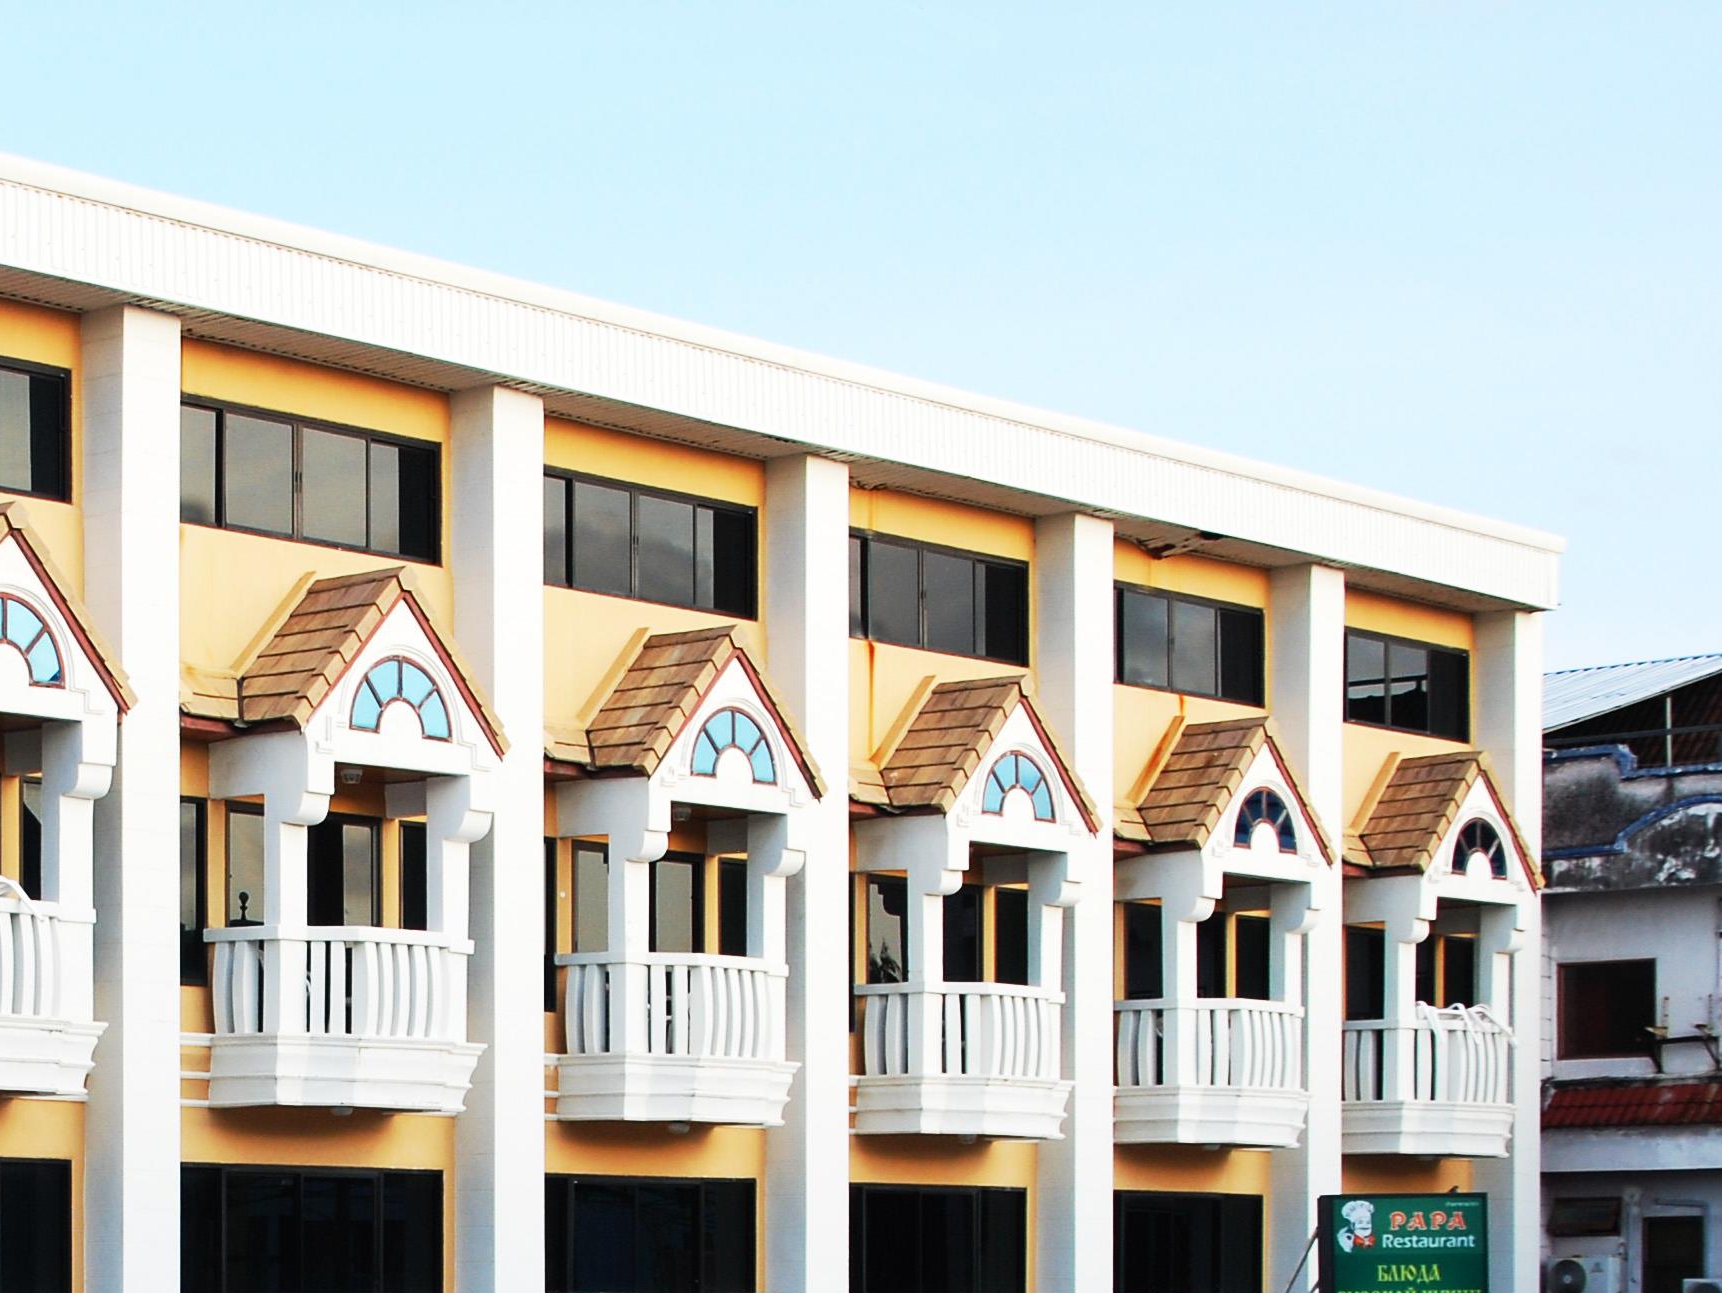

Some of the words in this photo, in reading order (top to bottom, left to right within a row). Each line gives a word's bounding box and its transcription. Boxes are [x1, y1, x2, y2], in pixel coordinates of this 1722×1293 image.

[1389, 1210, 1467, 1232] PAPA
[1381, 1233, 1476, 1249] Restaurant
[1377, 1263, 1441, 1284] БЛЮДА
